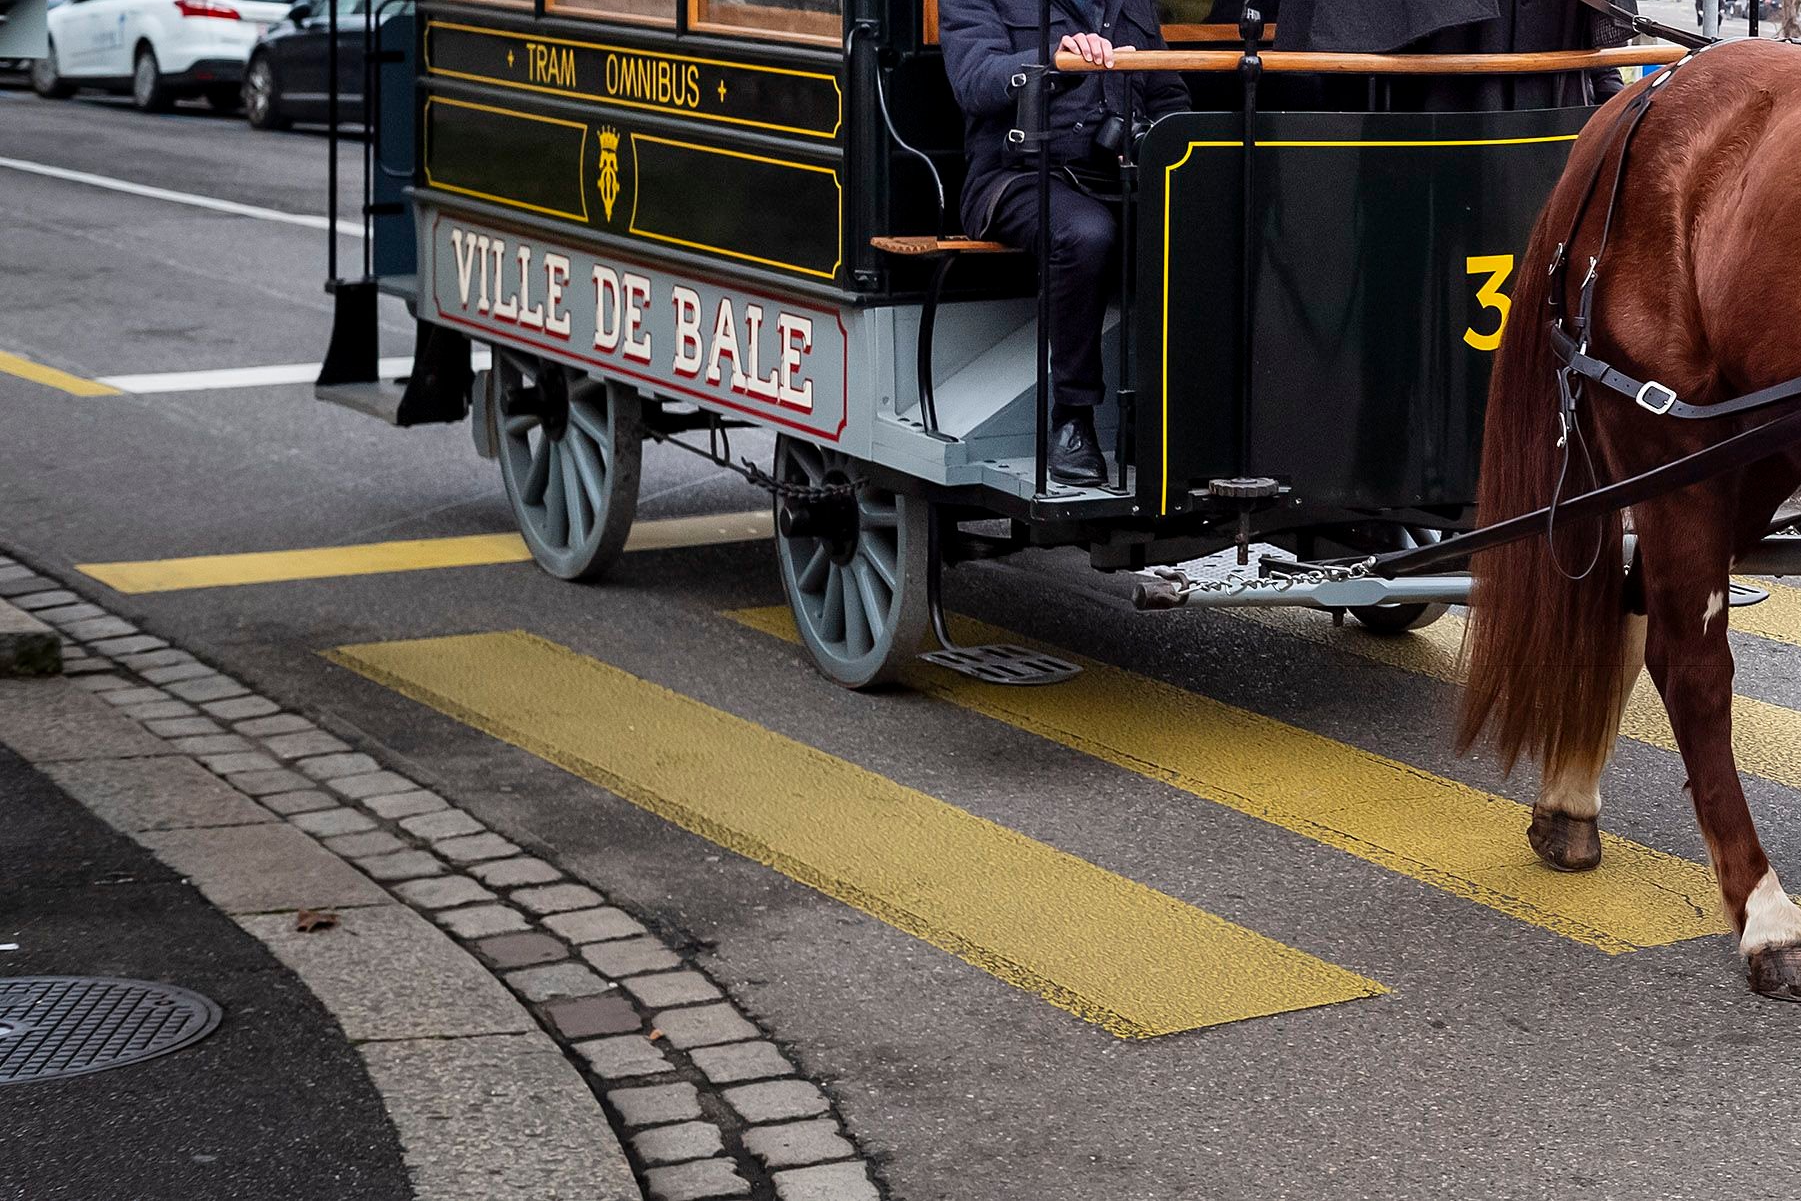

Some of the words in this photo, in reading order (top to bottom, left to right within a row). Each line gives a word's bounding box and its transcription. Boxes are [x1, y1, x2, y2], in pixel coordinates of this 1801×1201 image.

[526, 43, 577, 88] TRAM
[605, 53, 701, 108] OMNIBUS
[451, 229, 572, 338] VILLE
[591, 265, 652, 365] DE
[671, 286, 814, 414] BALE
[1463, 254, 1514, 350] 3
